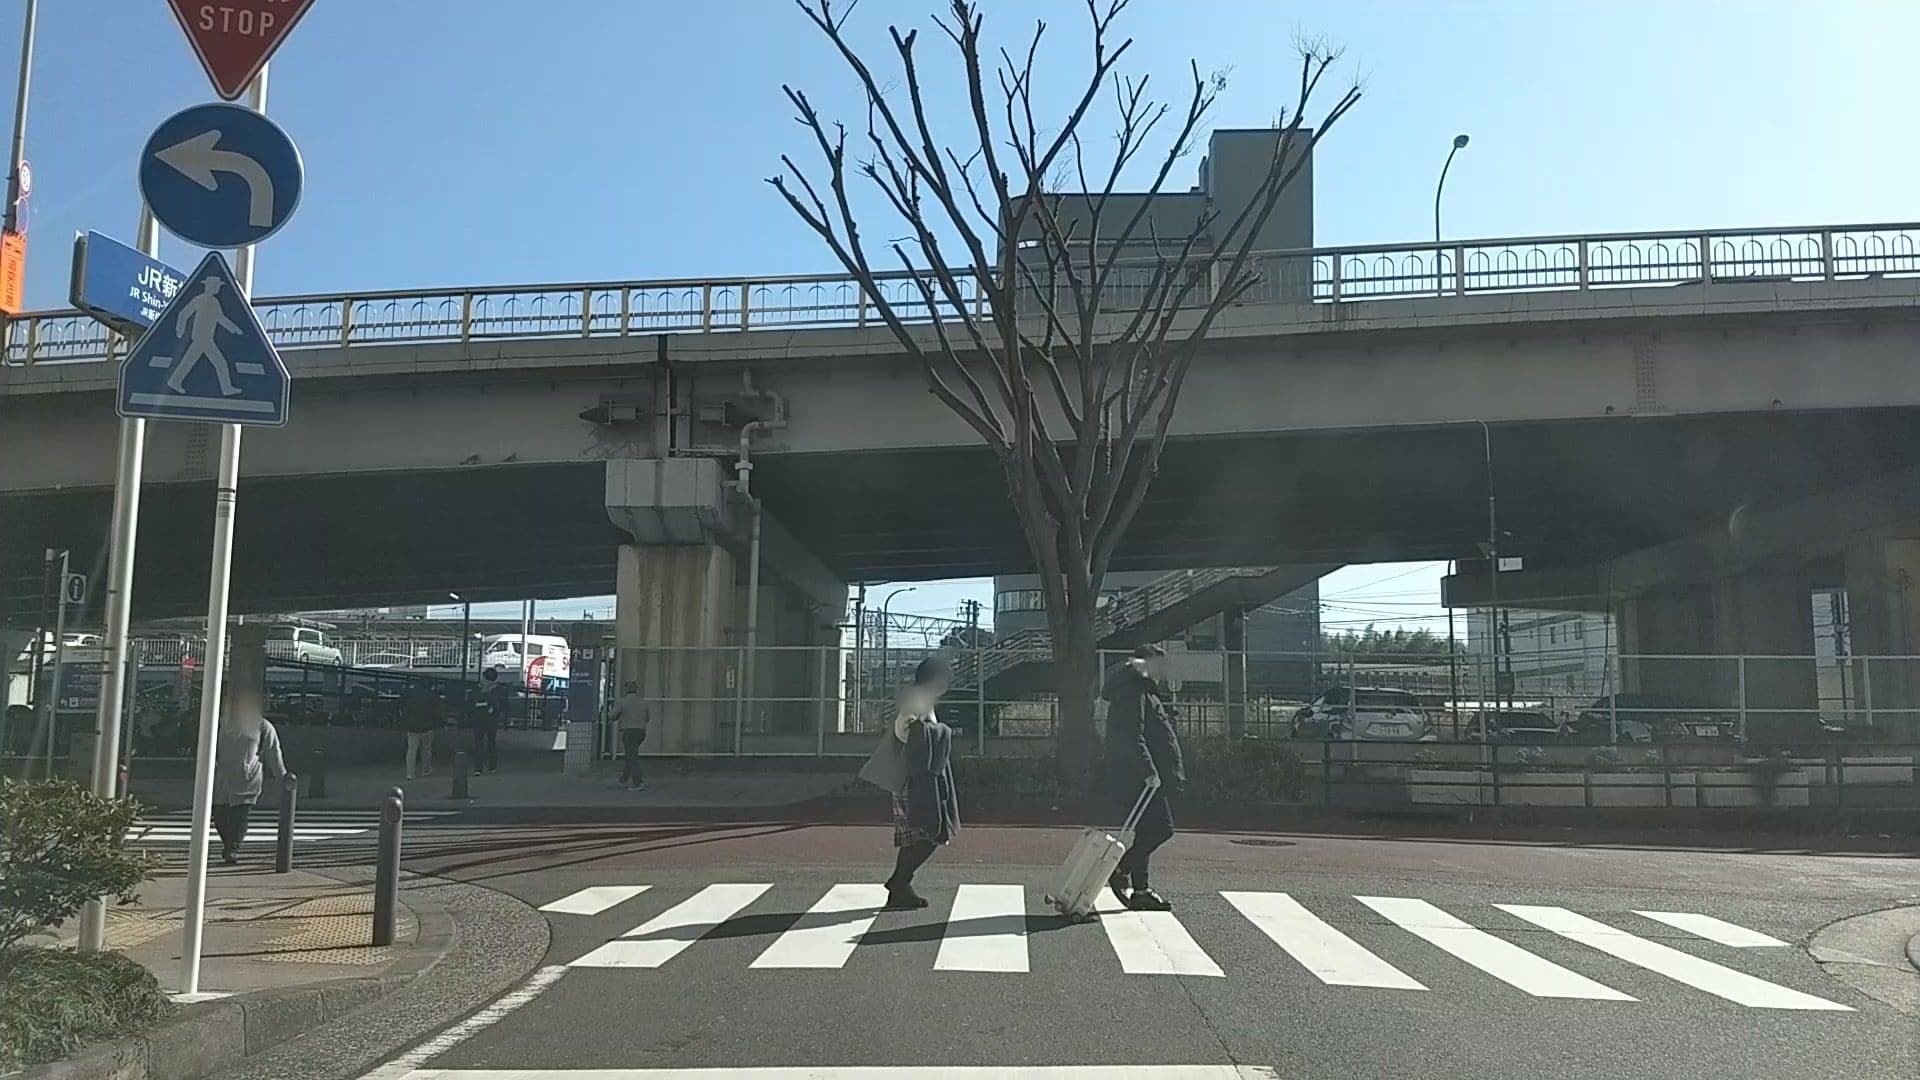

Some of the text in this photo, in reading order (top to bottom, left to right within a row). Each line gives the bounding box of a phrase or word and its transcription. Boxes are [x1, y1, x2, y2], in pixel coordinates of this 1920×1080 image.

[200, 5, 274, 36] STOP
[129, 286, 140, 300] JR
[137, 265, 183, 298] JR新
